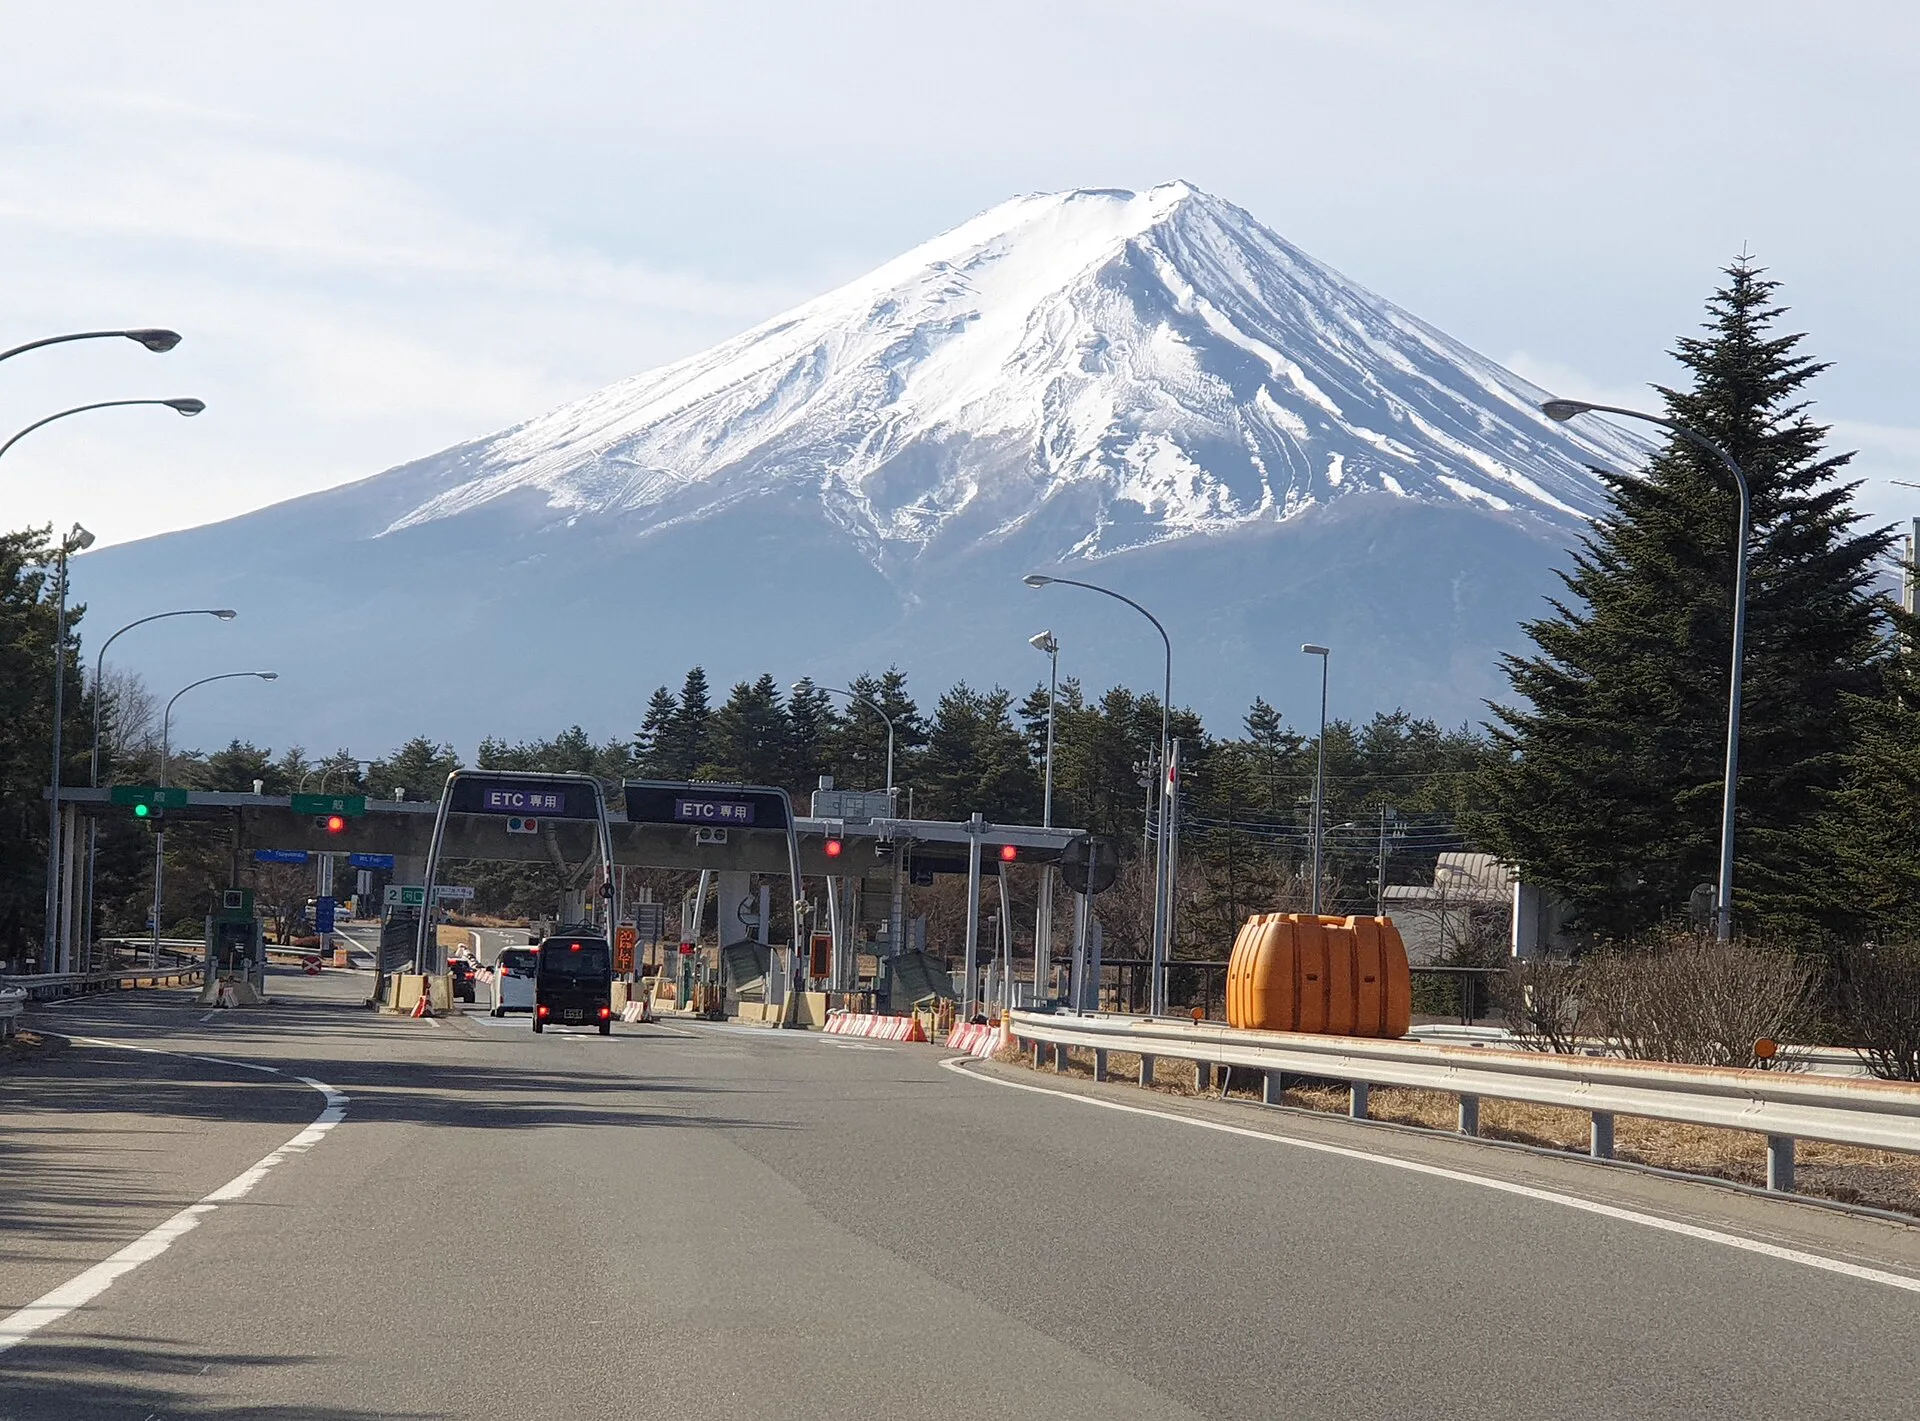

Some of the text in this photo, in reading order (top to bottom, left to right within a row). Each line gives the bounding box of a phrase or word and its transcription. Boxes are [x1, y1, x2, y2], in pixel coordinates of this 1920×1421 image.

[491, 792, 557, 808] ETC 専用
[682, 803, 747, 819] ETC 専用
[389, 889, 397, 900] 2
